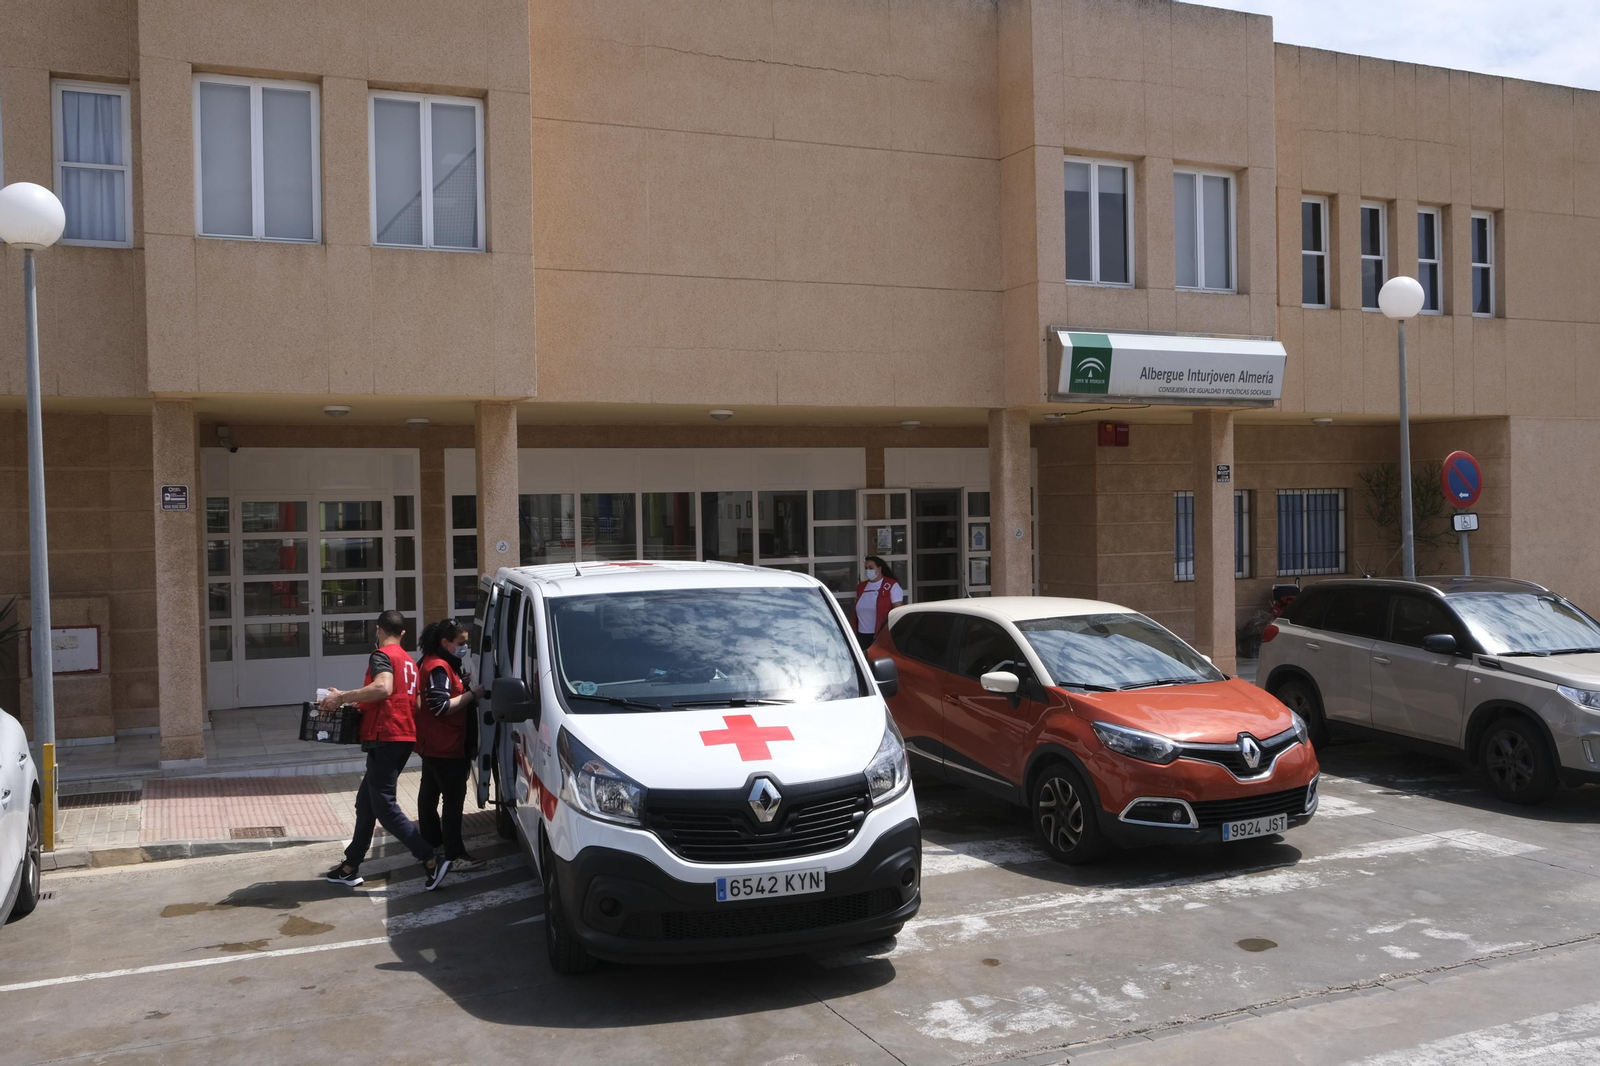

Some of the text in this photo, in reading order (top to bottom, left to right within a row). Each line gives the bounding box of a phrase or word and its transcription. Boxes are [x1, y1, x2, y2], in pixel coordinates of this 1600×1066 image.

[1140, 366, 1274, 385] Albergue Inturjoven Almería
[1158, 386, 1188, 394] CONSEJERÍA
[1196, 387, 1221, 395] IGUALDAD
[1226, 387, 1249, 396] POLÍTICAS
[1231, 816, 1285, 837] 9924 JST
[730, 871, 820, 897] 6542 KYN
